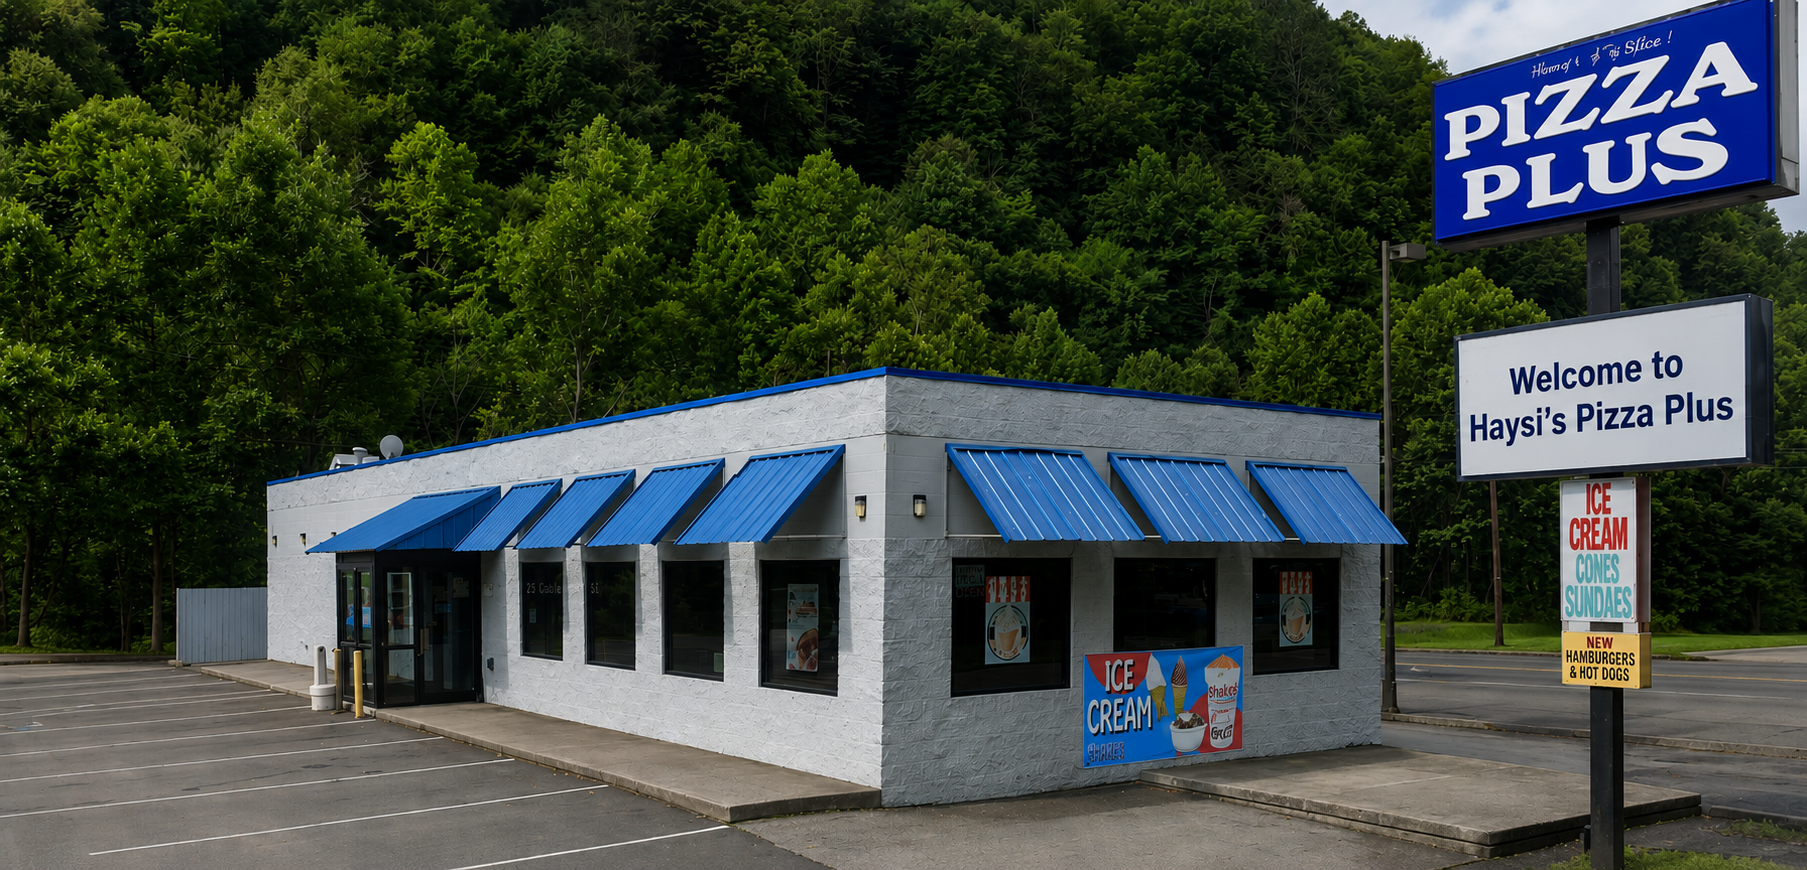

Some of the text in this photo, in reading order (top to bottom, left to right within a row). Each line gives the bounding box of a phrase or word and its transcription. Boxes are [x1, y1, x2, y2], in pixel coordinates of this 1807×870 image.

[1444, 41, 1759, 161] PIZZA
[1461, 118, 1729, 221] PLUS
[1509, 351, 1684, 395] Welcome to
[1469, 392, 1735, 447] Haysi’s Pizza Plus
[1585, 482, 1612, 515] ICE
[1569, 517, 1629, 551] CREAM
[1575, 553, 1620, 584] CONES
[1565, 585, 1632, 619] SUNDAES
[1566, 650, 1636, 667] HAMBURGERS
[1586, 636, 1614, 650] NEW
[1105, 659, 1135, 694] ICE
[1569, 666, 1630, 682] & HOT DOGS
[1087, 695, 1152, 736] CREAM
